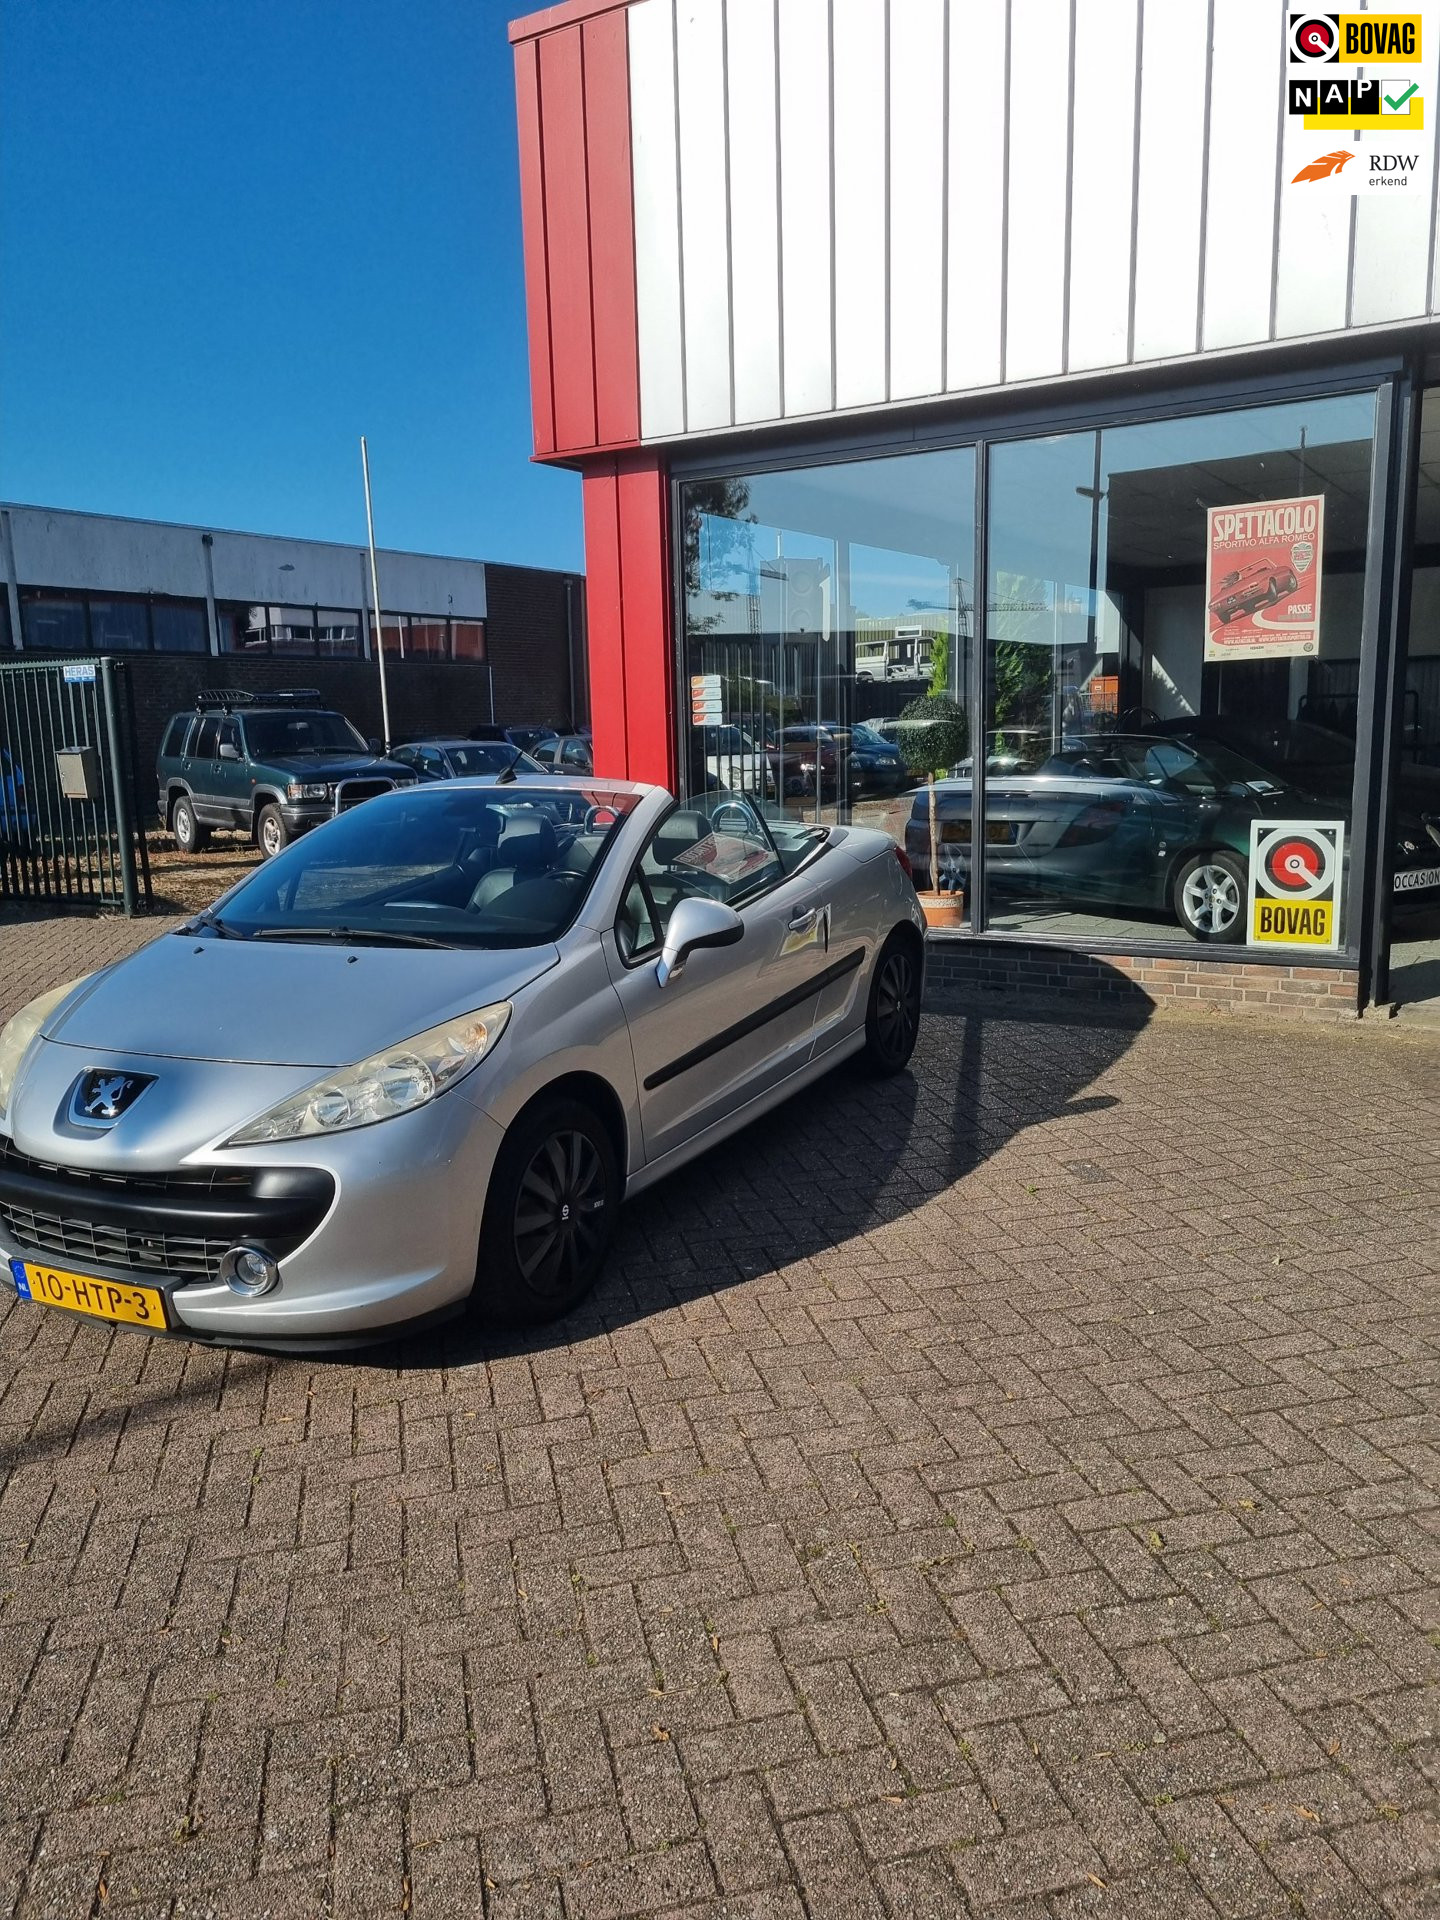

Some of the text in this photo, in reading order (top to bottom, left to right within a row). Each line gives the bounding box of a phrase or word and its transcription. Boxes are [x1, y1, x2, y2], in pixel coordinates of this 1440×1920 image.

[1213, 505, 1316, 542] SPETTACOLO
[1213, 533, 1315, 550] SPORTIVO ALFA ROMEO
[1287, 604, 1312, 615] PASSIE
[65, 666, 94, 676] HERAS
[1394, 868, 1440, 889] OCCASION
[1260, 906, 1326, 936] BOVAG
[18, 1283, 29, 1292] NL
[35, 1271, 150, 1320] 10-HTP-3
